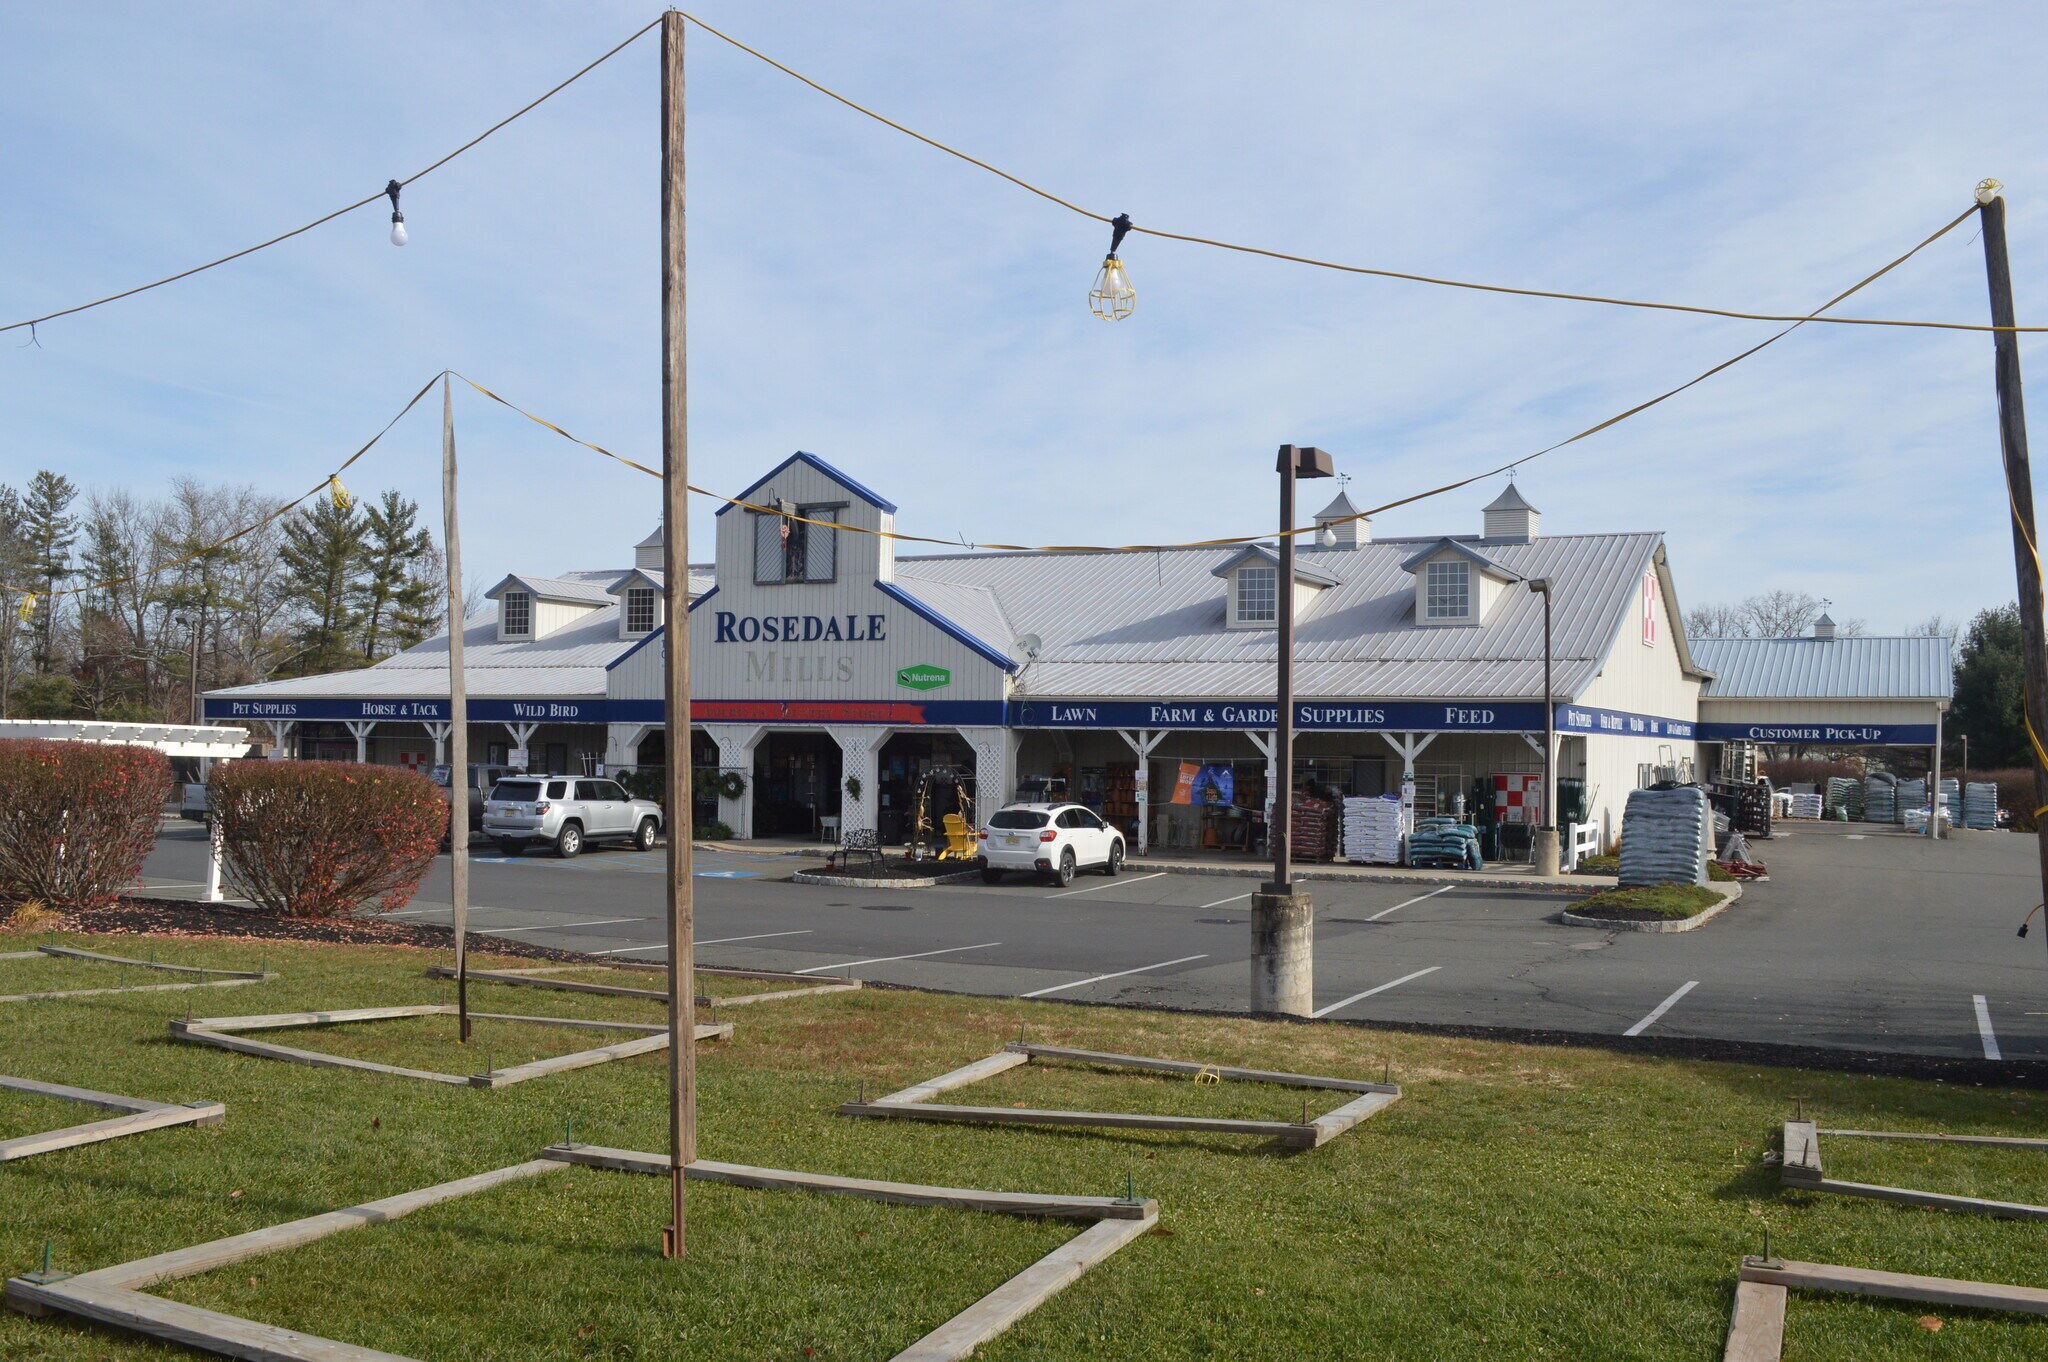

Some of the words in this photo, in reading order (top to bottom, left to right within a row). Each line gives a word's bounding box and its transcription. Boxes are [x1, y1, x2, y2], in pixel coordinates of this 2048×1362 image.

[714, 611, 887, 643] ROSEDALE
[745, 650, 854, 683] MILLS
[912, 673, 945, 682] Nutrena
[233, 702, 250, 714] PET
[252, 702, 297, 715] SUPPLIES
[362, 702, 397, 715] HORSE
[400, 704, 408, 715] &
[411, 702, 438, 716] TACK
[513, 703, 546, 717] WILD
[549, 703, 579, 717] BIRD
[1051, 705, 1097, 721] LAWN
[1150, 706, 1197, 722] FARM
[1203, 708, 1215, 722] &
[1222, 706, 1278, 723] GARDE
[1300, 706, 1385, 724] SUPPLIES
[1445, 707, 1495, 724] FEED
[1749, 726, 1820, 739] CUSTOMER
[1825, 727, 1881, 740] PICK-UP
